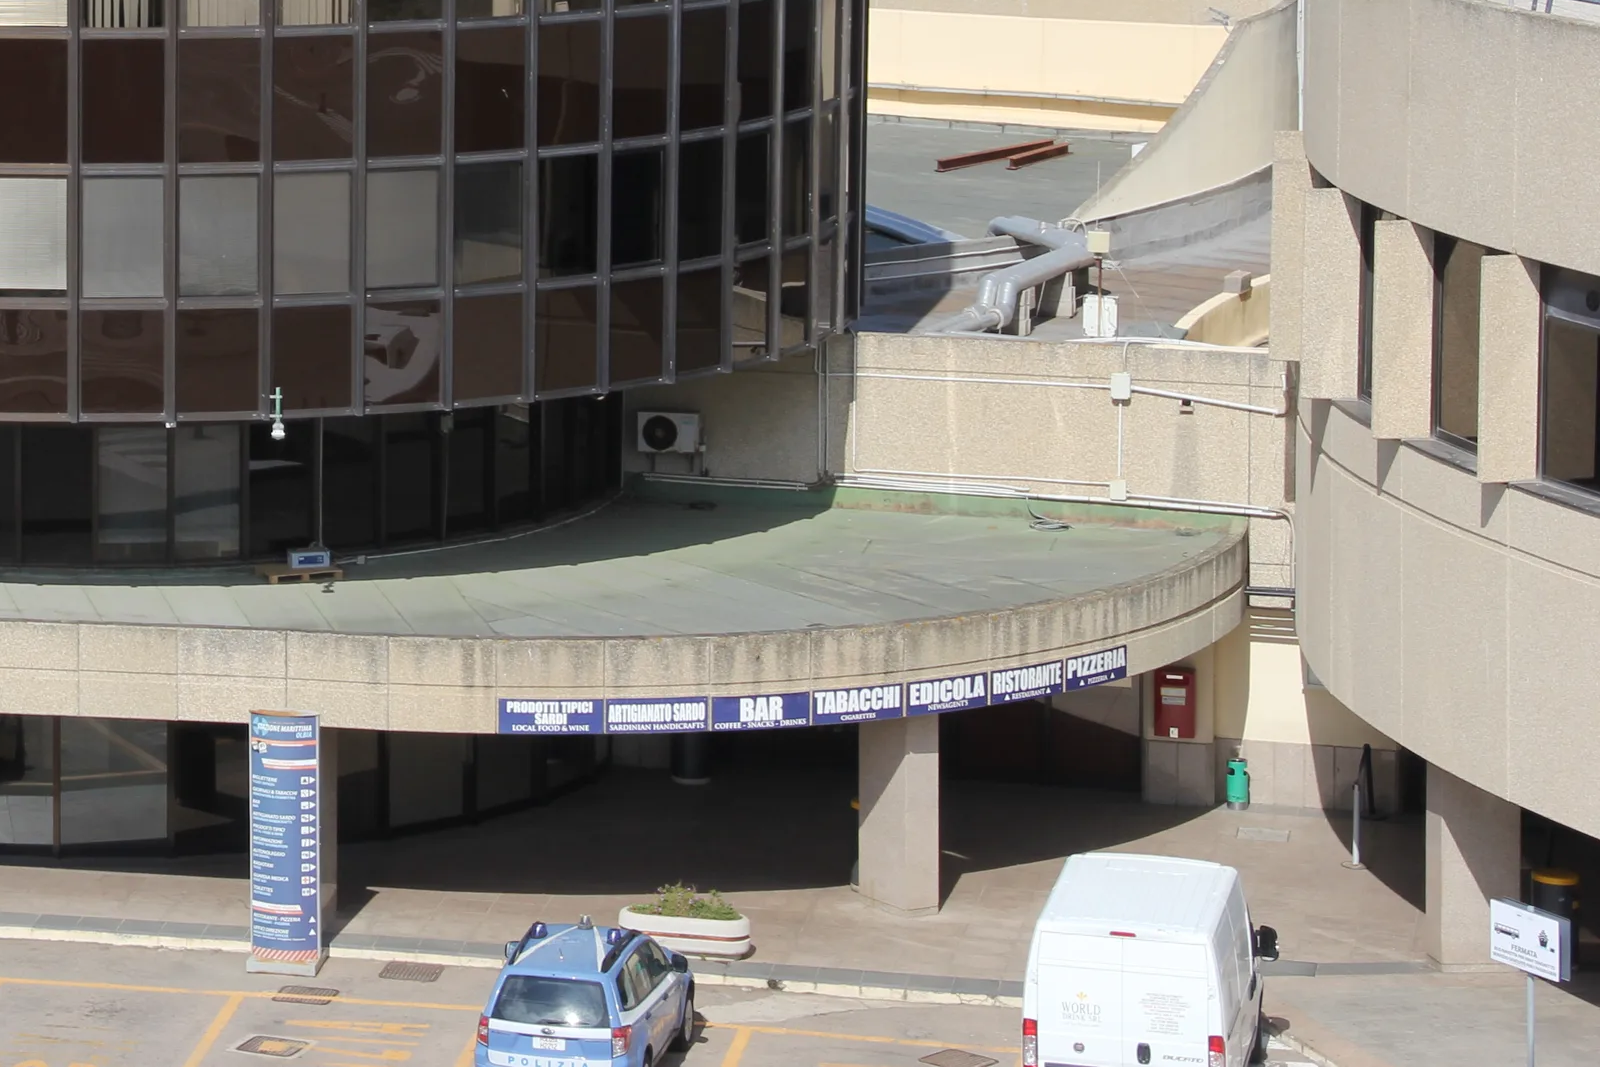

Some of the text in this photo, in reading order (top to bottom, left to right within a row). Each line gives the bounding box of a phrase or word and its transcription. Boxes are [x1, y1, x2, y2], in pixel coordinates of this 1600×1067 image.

[1067, 647, 1126, 680] PIZZERIA
[992, 661, 1062, 695] RISTORANTE
[909, 675, 986, 706] EDICOLA
[1011, 687, 1046, 700] RESTAURANT
[814, 685, 901, 715] TABACCHI
[506, 701, 593, 714] PRODOTTI TIPICI
[608, 702, 706, 723] ARTIGIANATO SARDO
[739, 696, 784, 722] BAR
[534, 713, 568, 725] SARDI
[840, 712, 876, 721] CIGARETTES
[512, 724, 537, 732] LOCAL
[537, 724, 561, 732] FOOD
[609, 721, 705, 731] SARDINIAN HANDICRAFTS
[714, 722, 742, 730] COFFEE
[747, 720, 775, 729] SNACKS
[780, 718, 807, 727] DRINKS
[1510, 943, 1538, 959] FERMATA
[1061, 1001, 1101, 1016] WORLD
[507, 1055, 589, 1067] POLIZIA
